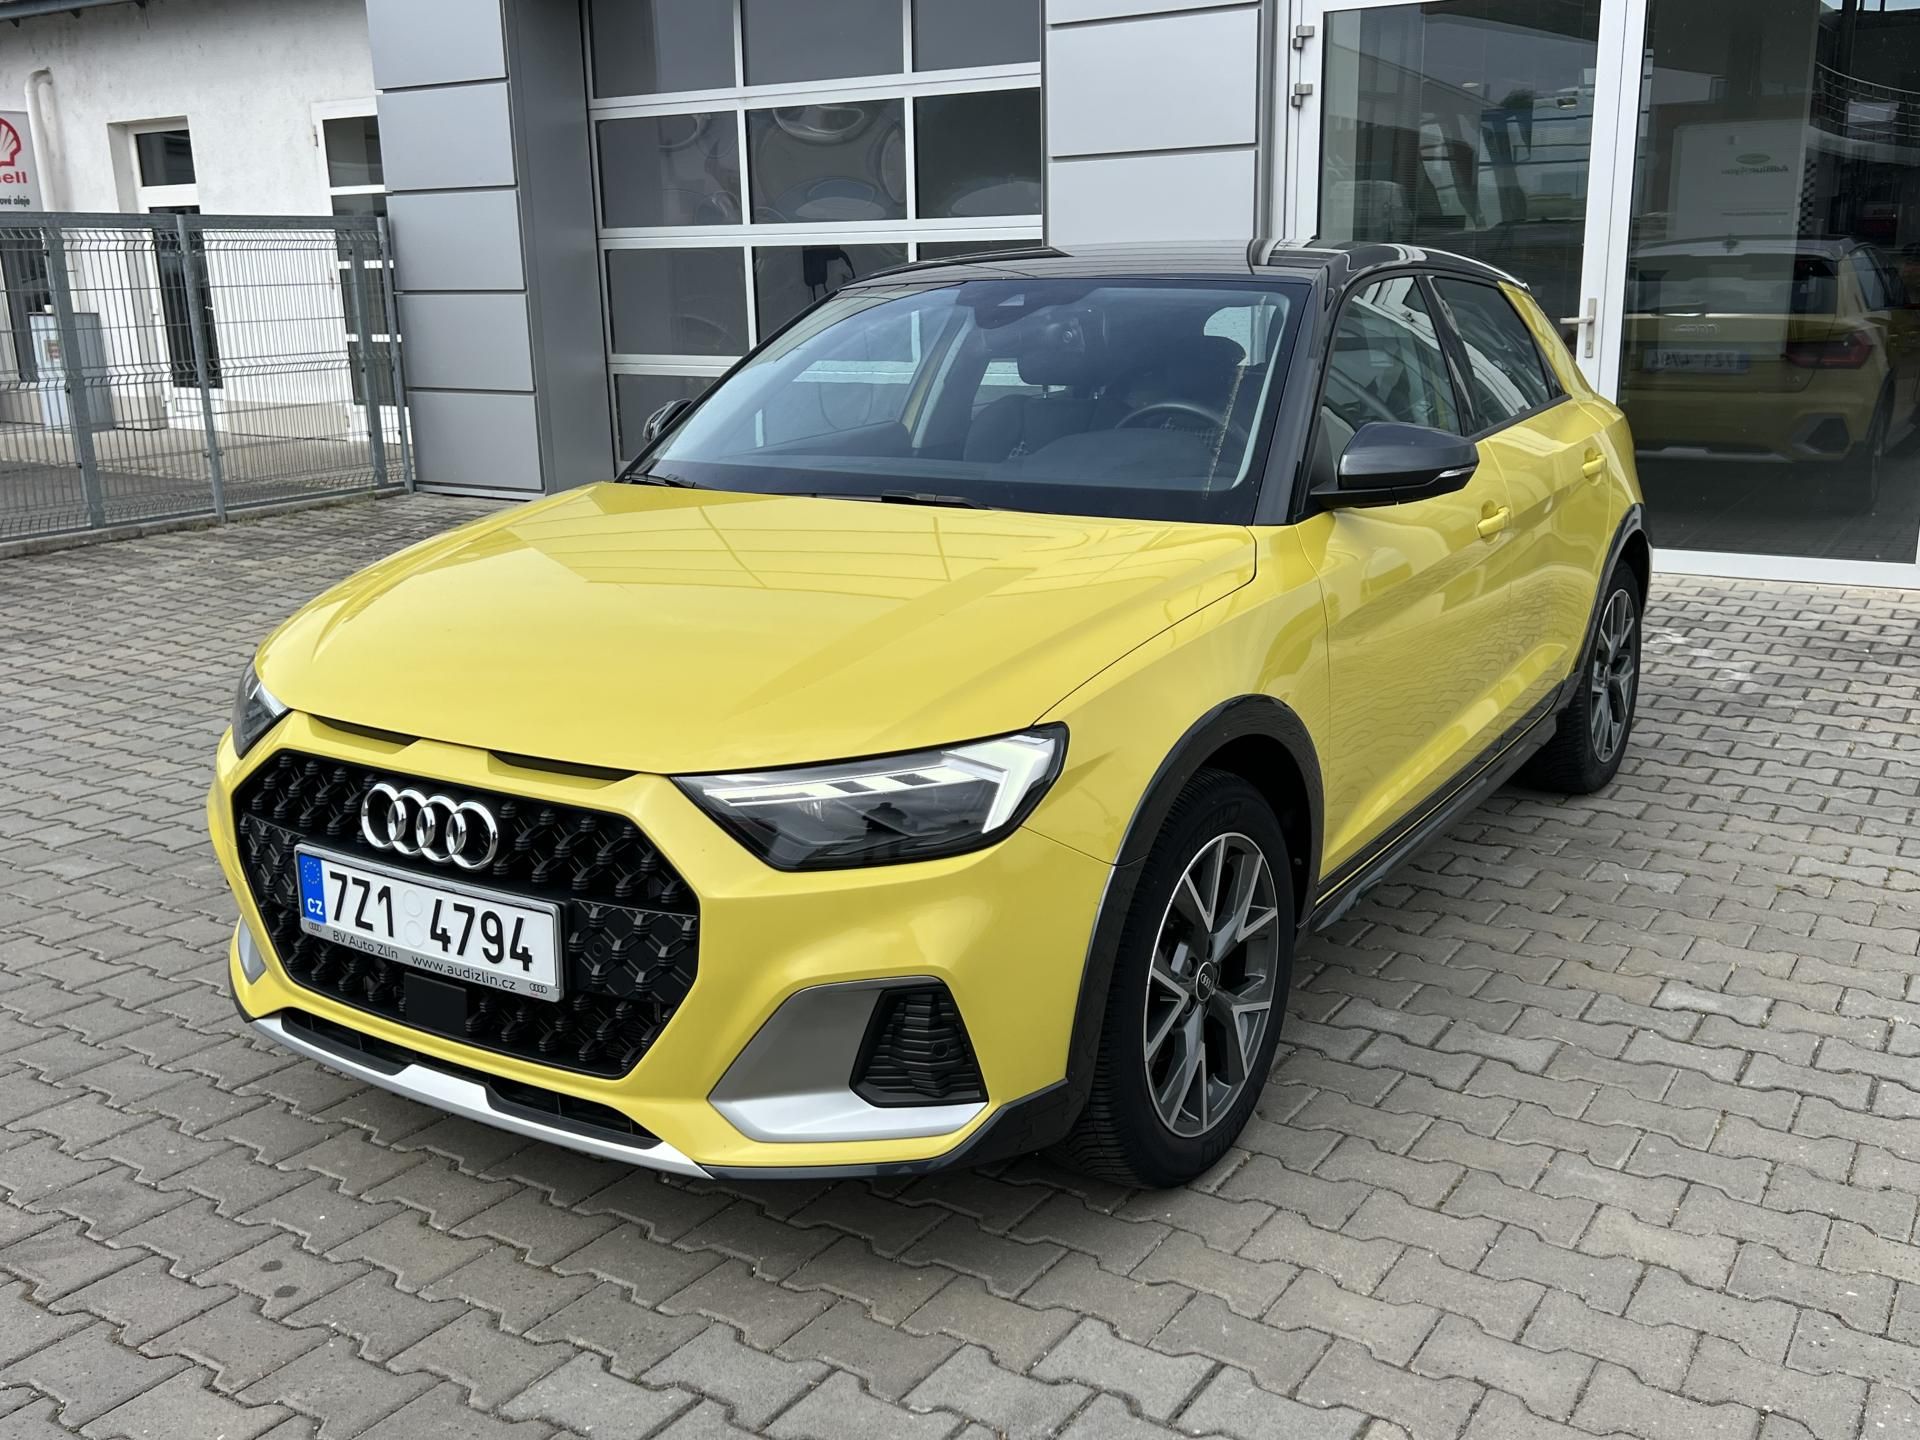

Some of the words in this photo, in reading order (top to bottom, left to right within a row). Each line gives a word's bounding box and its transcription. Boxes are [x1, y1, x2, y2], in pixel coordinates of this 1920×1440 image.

[0, 171, 27, 183] ell
[307, 898, 324, 915] CZ
[329, 871, 394, 938] 7Z1
[430, 898, 533, 972] 4794
[333, 930, 347, 943] BV
[349, 936, 375, 952] Auto
[411, 955, 516, 990] www.audizlin.cz
